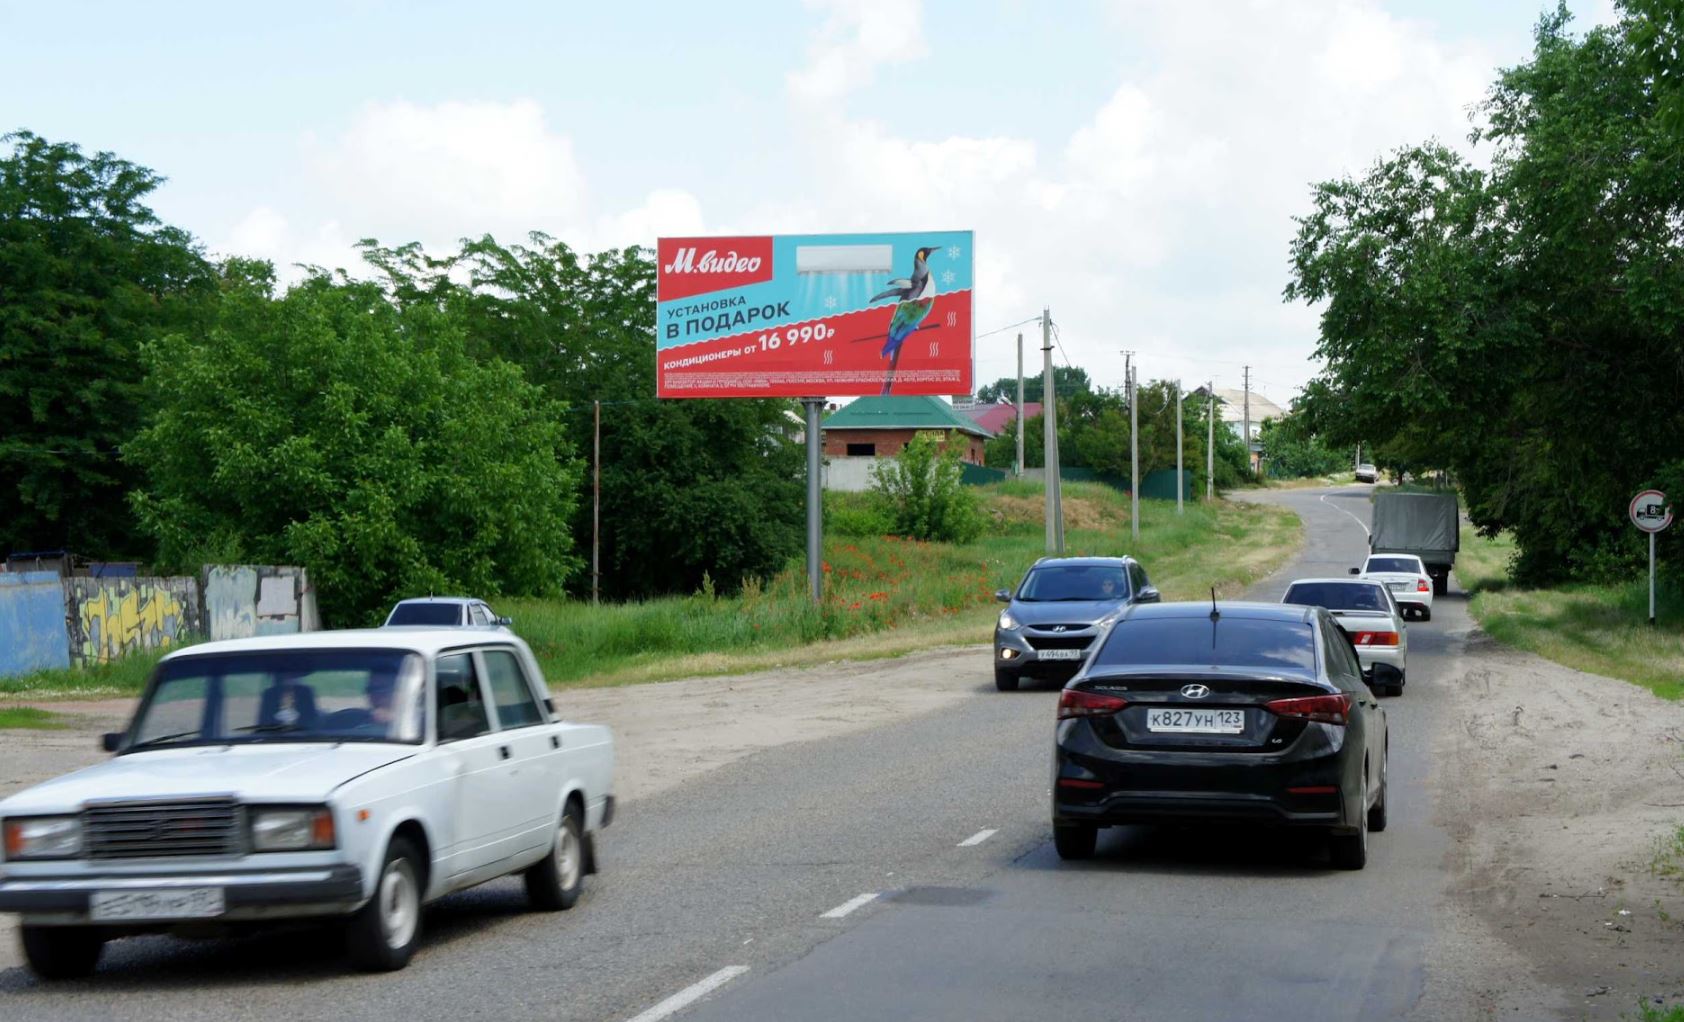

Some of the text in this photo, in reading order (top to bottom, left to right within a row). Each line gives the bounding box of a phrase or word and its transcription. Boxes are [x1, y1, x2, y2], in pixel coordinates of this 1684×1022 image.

[666, 301, 791, 339] В ПОДАРОК
[667, 296, 747, 319] УСТАНОВКА
[664, 348, 742, 370] КОНДИЦИОНЕРЫ
[758, 332, 781, 351] 16
